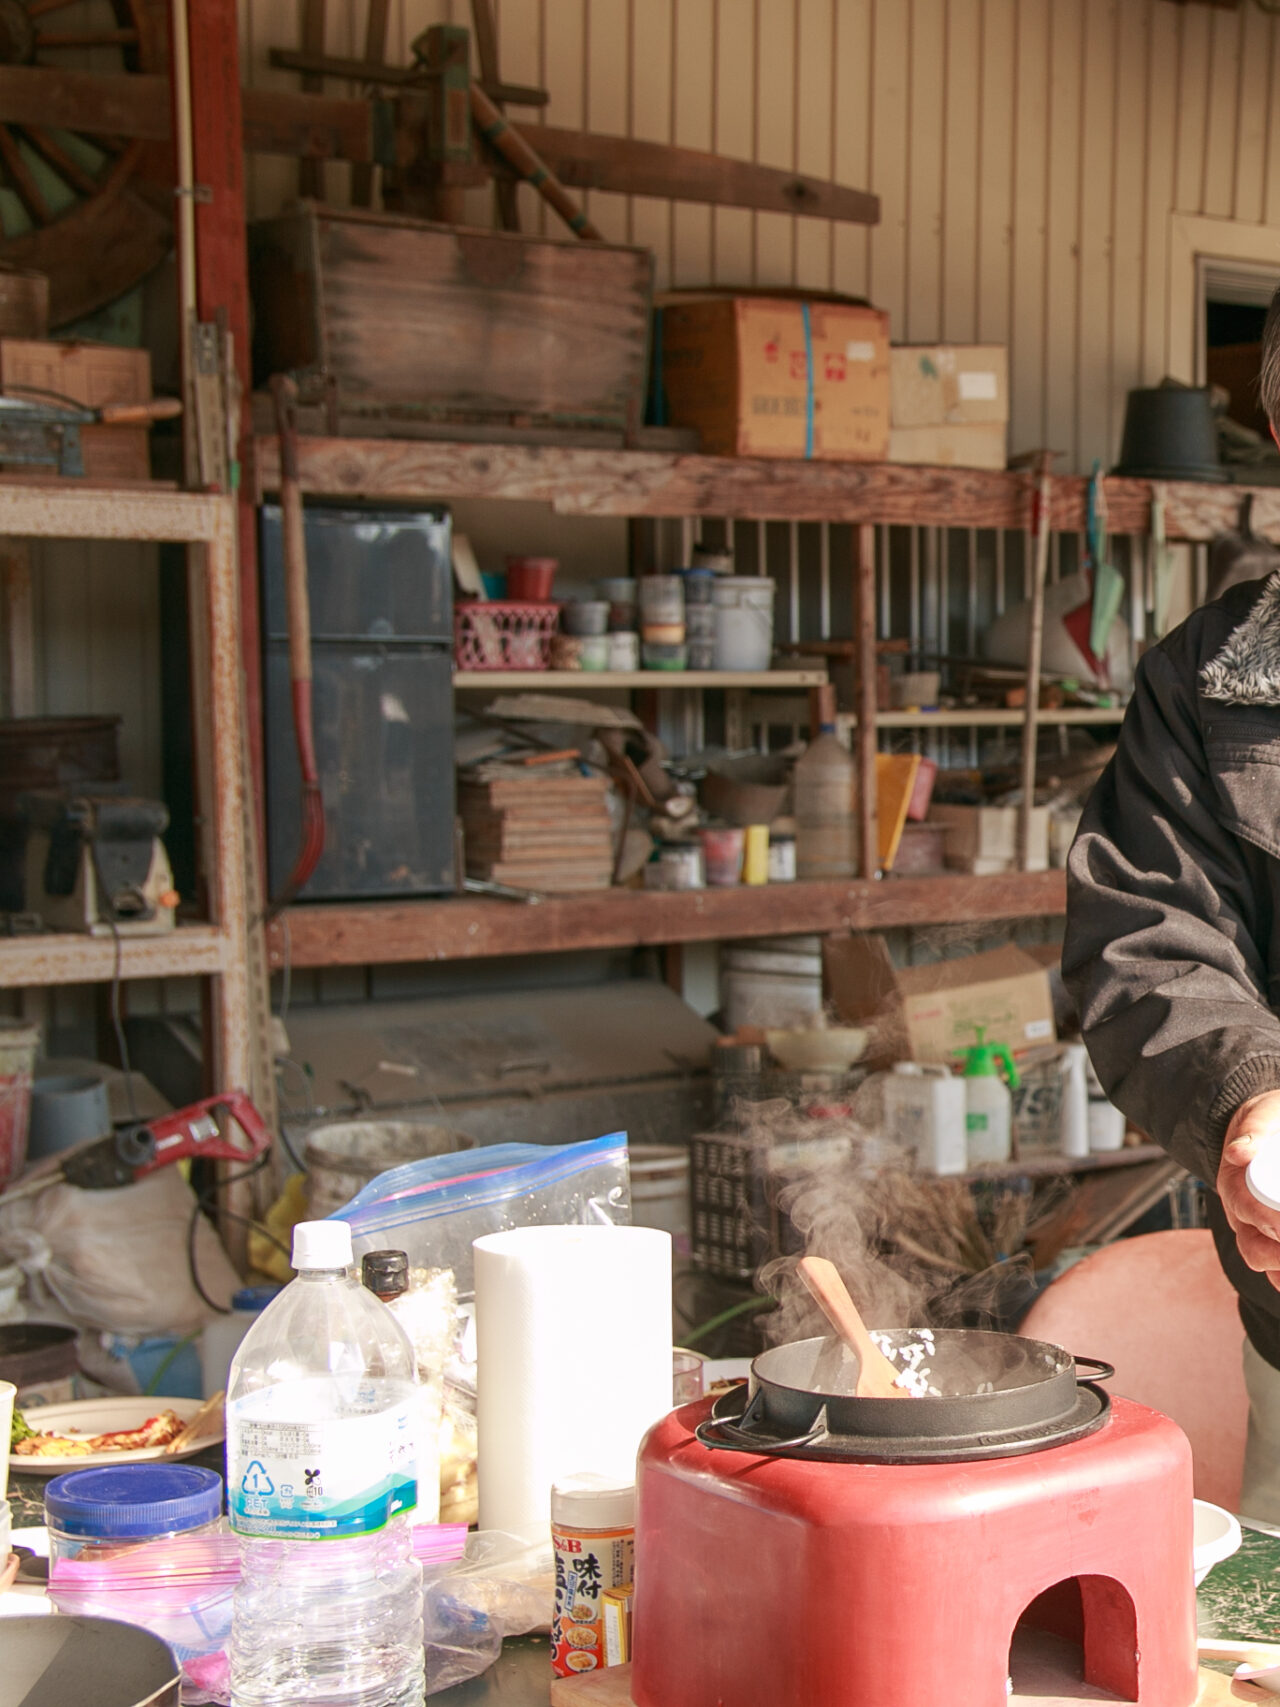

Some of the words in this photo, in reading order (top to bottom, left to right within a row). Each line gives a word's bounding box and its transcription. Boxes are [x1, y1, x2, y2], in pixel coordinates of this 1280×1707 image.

[252, 1473, 258, 1488] 1
[246, 1498, 268, 1508] PET
[553, 1536, 582, 1553] S&B
[572, 1553, 602, 1600] 味付
